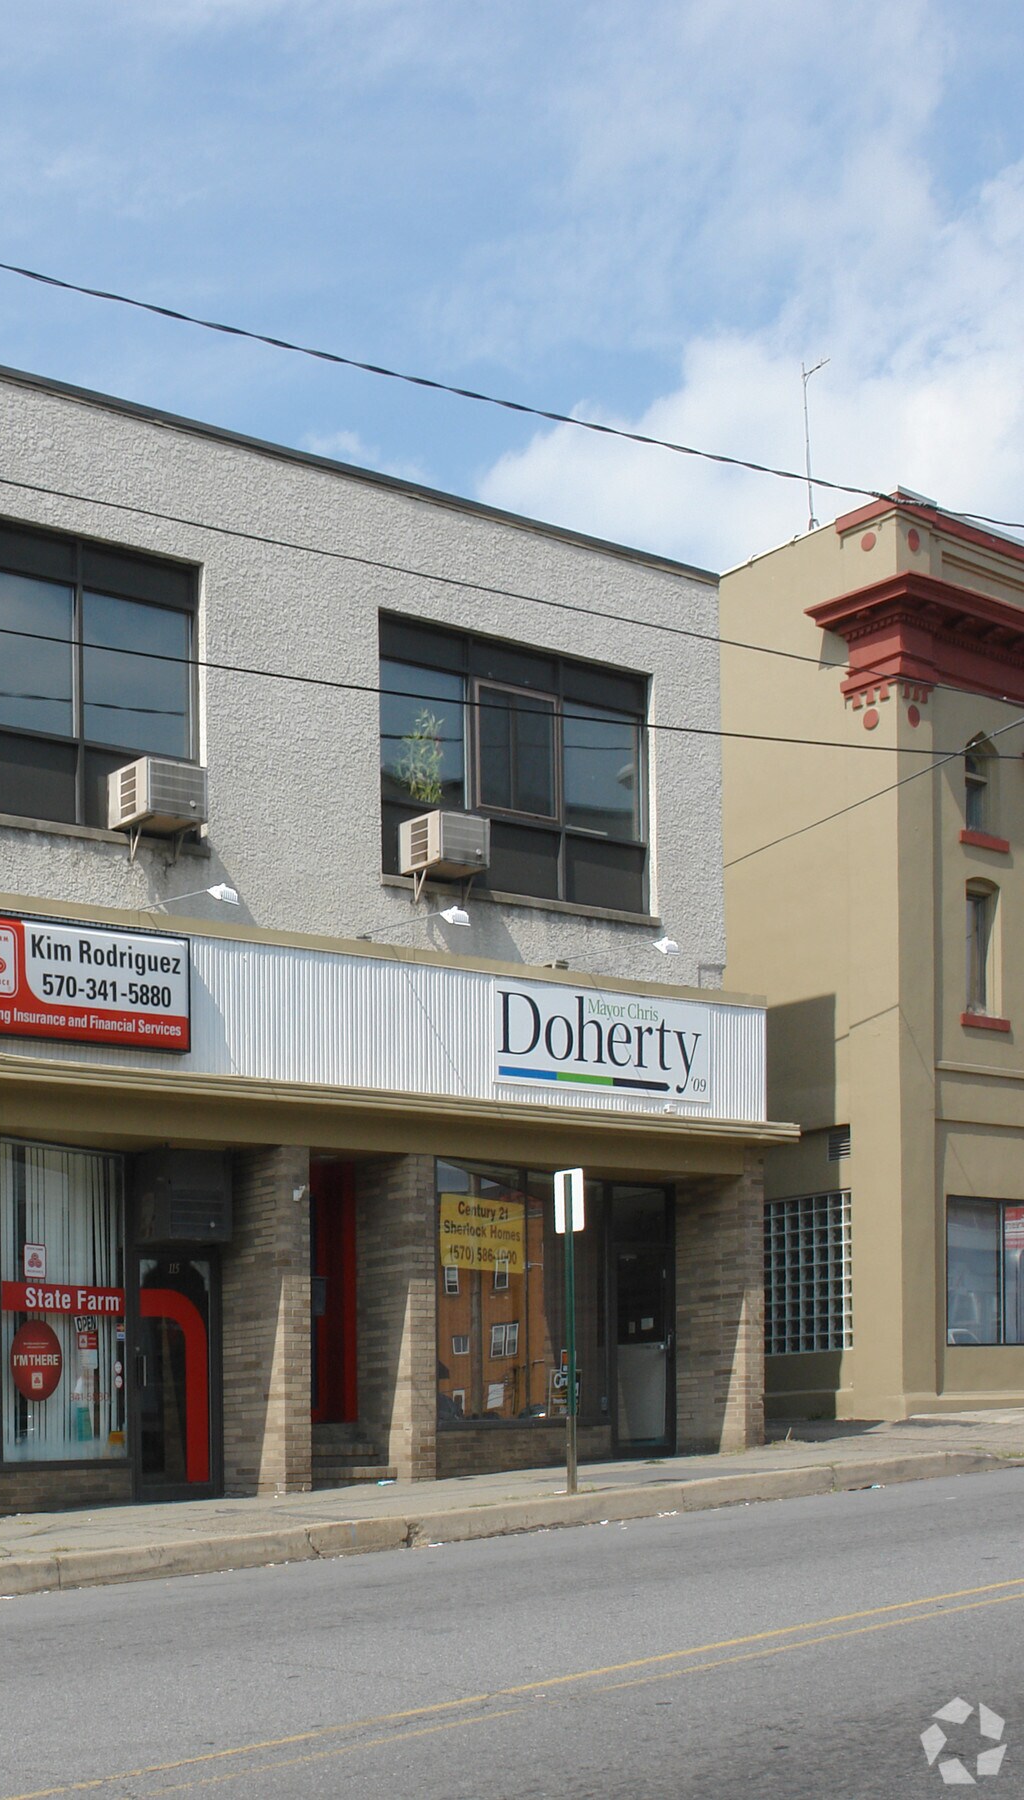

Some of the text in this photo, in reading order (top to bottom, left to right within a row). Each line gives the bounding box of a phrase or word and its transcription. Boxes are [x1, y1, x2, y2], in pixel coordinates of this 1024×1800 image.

[31, 934, 182, 976] Kim Rodriguez
[42, 973, 172, 1008] 570-341-5880
[13, 1006, 65, 1027] Insurance
[68, 1013, 87, 1029] and
[90, 1014, 136, 1033] Financial
[138, 1020, 182, 1037] Services
[588, 998, 659, 1022] Mayor Chris
[497, 990, 702, 1094] Doherty
[457, 1201, 509, 1222] Century 21
[443, 1219, 521, 1242] Sherlock Homes
[450, 1244, 475, 1265] (570)
[25, 1287, 120, 1312] State Farm
[76, 1315, 97, 1332] OPEN
[13, 1354, 59, 1367] I'M THERE
